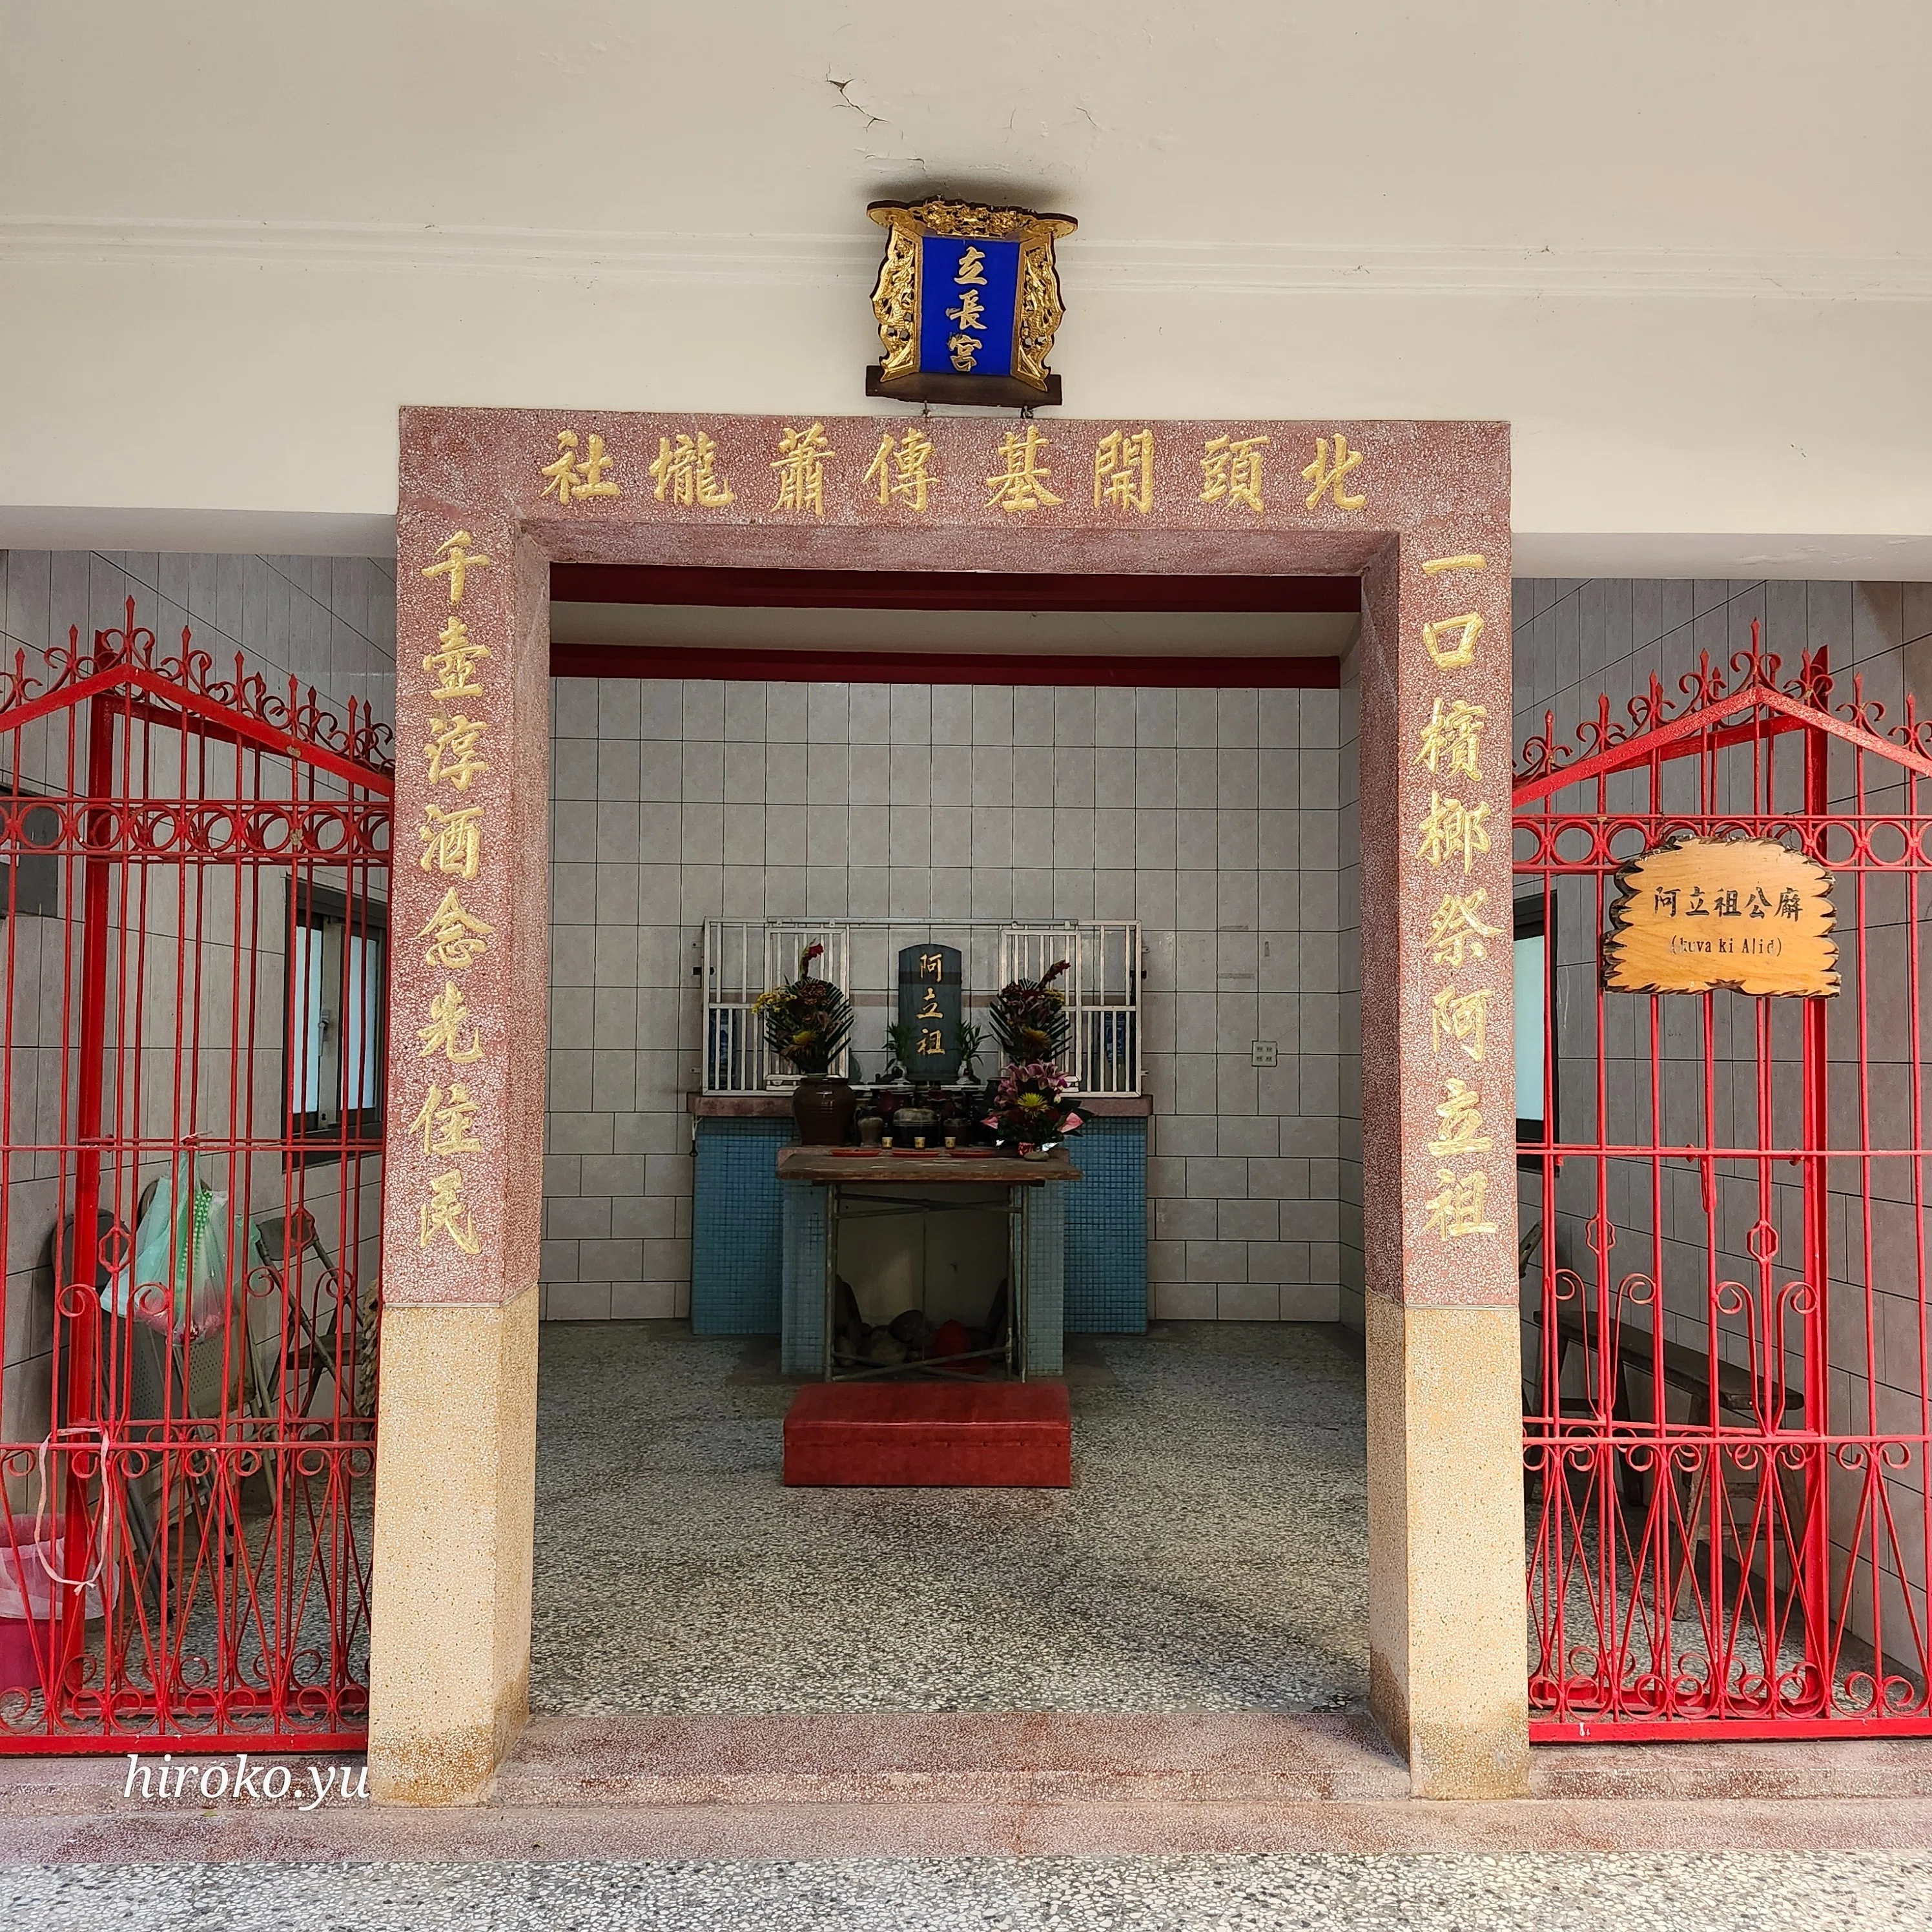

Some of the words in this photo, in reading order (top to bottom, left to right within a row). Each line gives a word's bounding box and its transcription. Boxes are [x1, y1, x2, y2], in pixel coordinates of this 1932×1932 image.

[945, 245, 988, 373] 立長宮
[1718, 938, 1734, 954] ki
[916, 953, 946, 1054] 阿立祖
